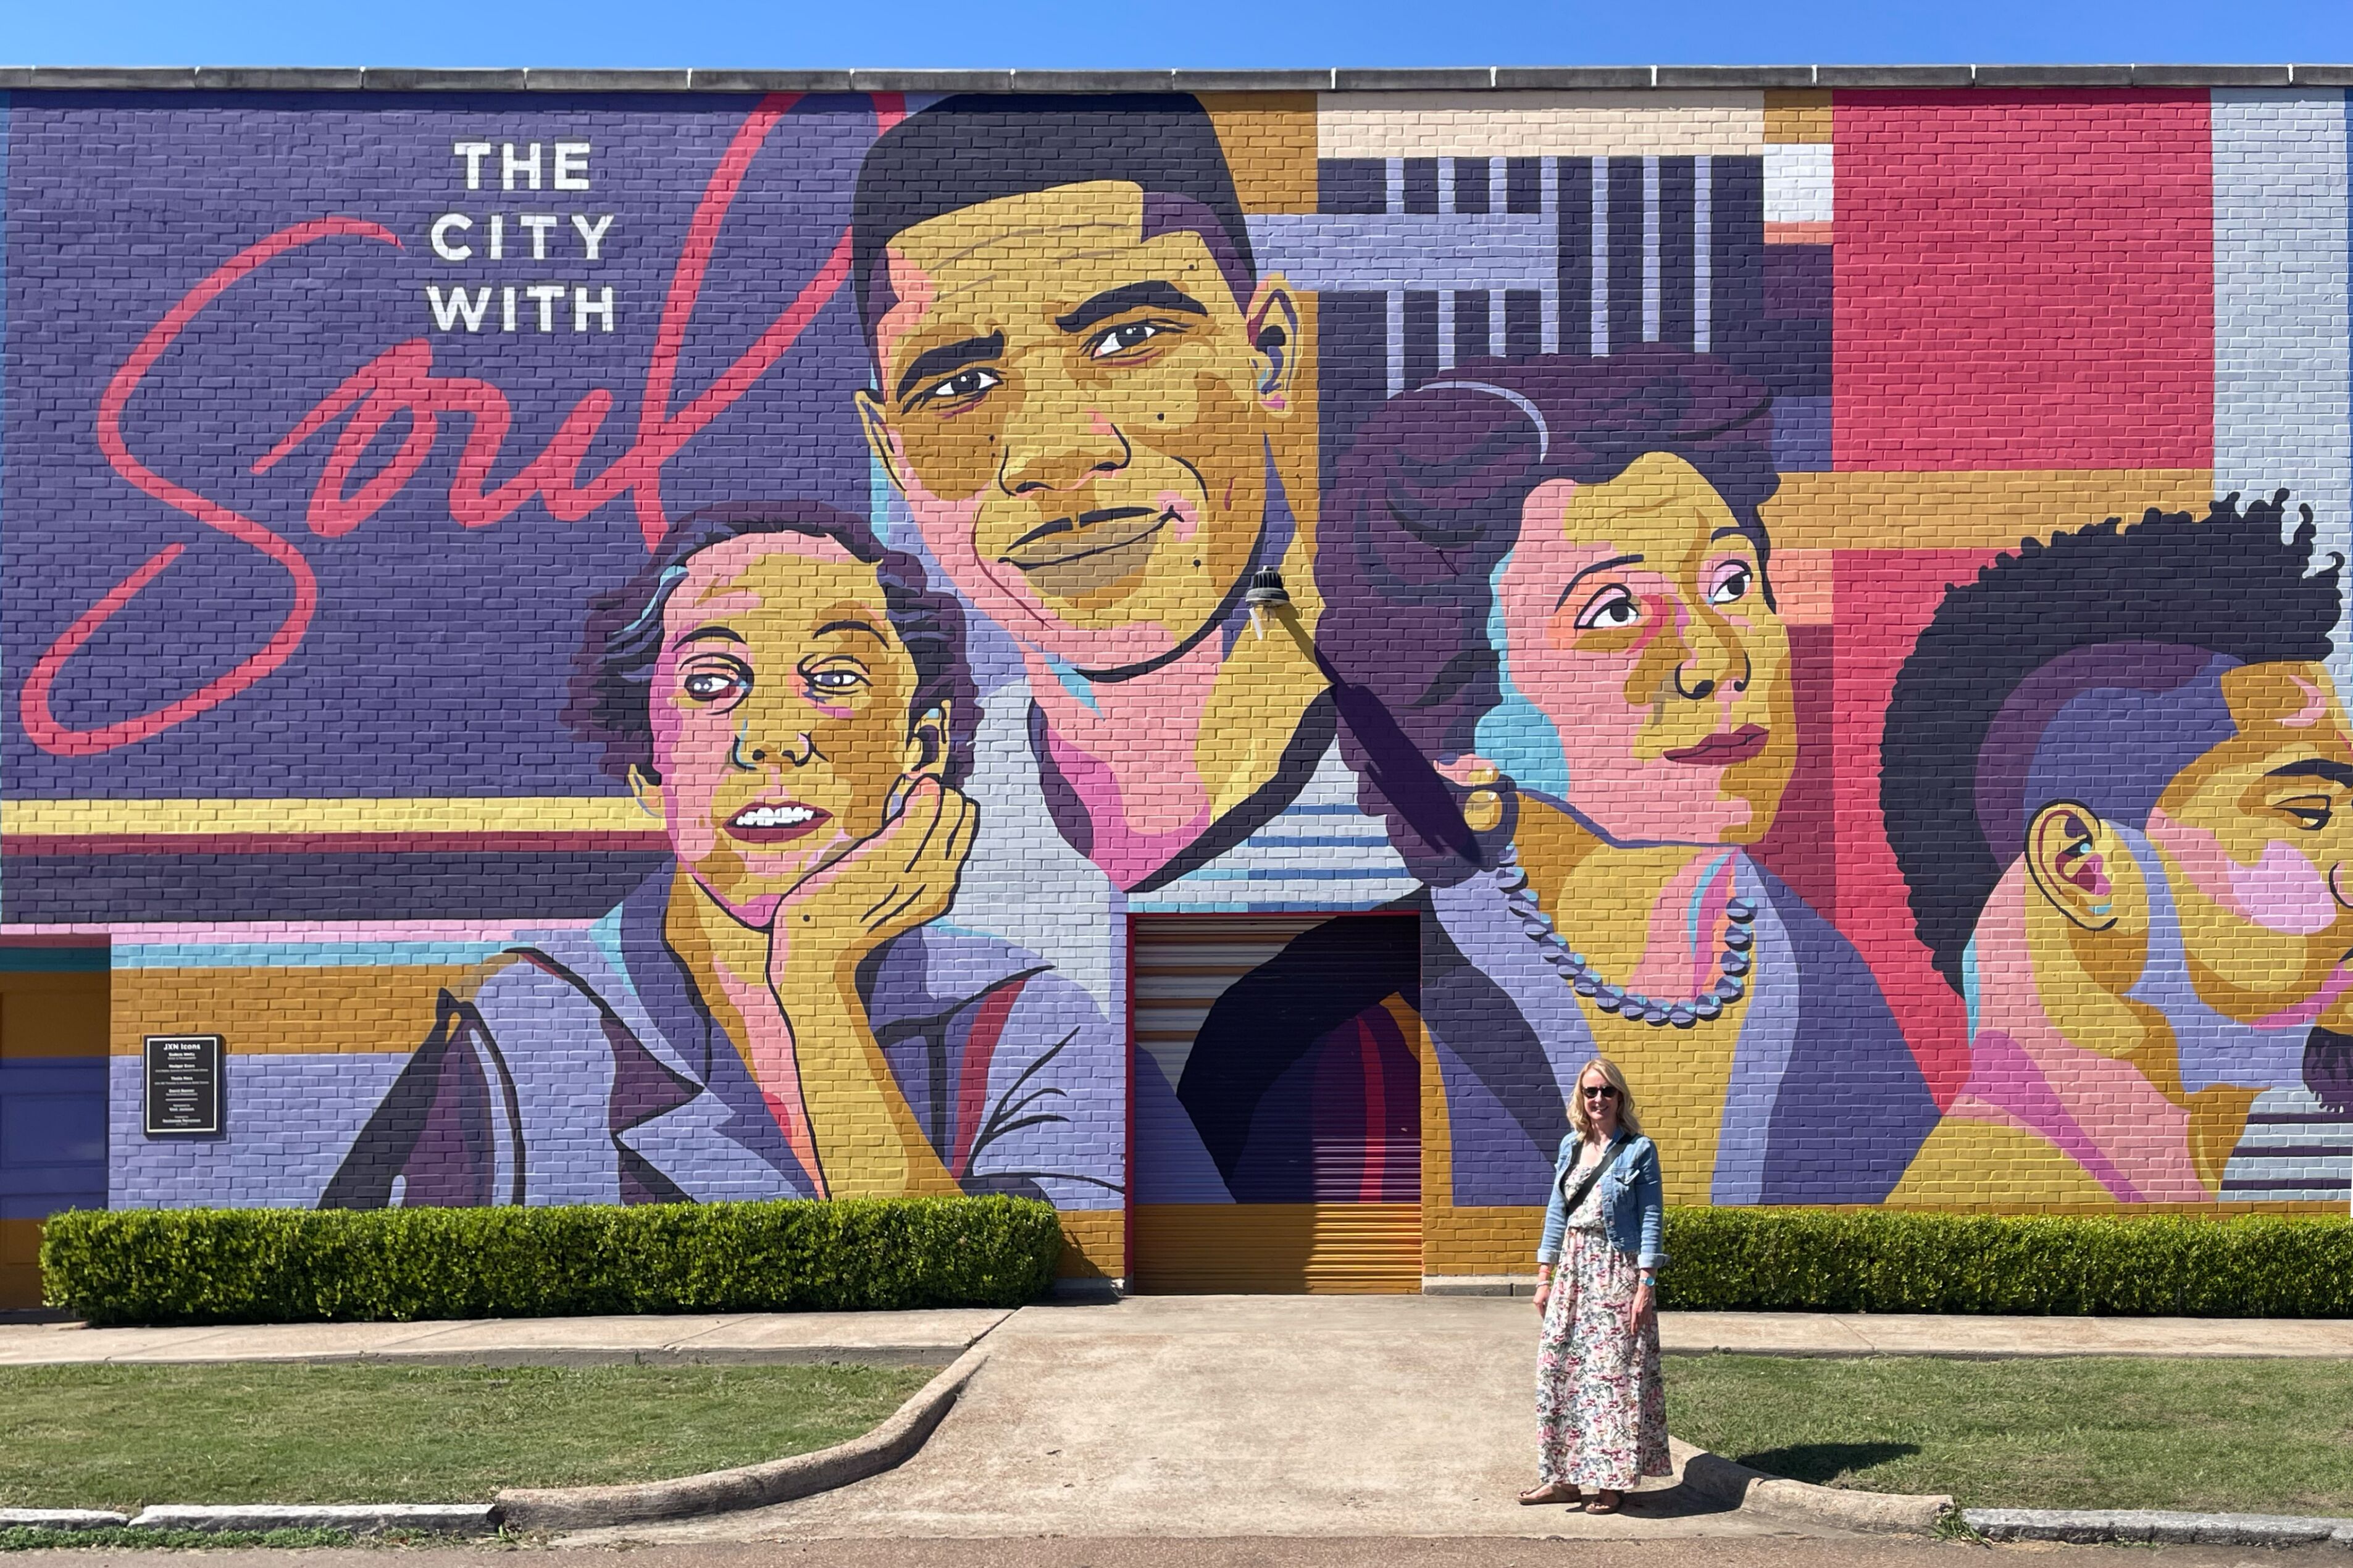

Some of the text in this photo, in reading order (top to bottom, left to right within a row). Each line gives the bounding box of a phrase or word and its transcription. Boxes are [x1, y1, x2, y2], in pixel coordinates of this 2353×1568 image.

[454, 143, 590, 190] THE
[430, 213, 614, 261] CITY
[426, 286, 614, 332] WITH
[21, 92, 906, 755] Soul
